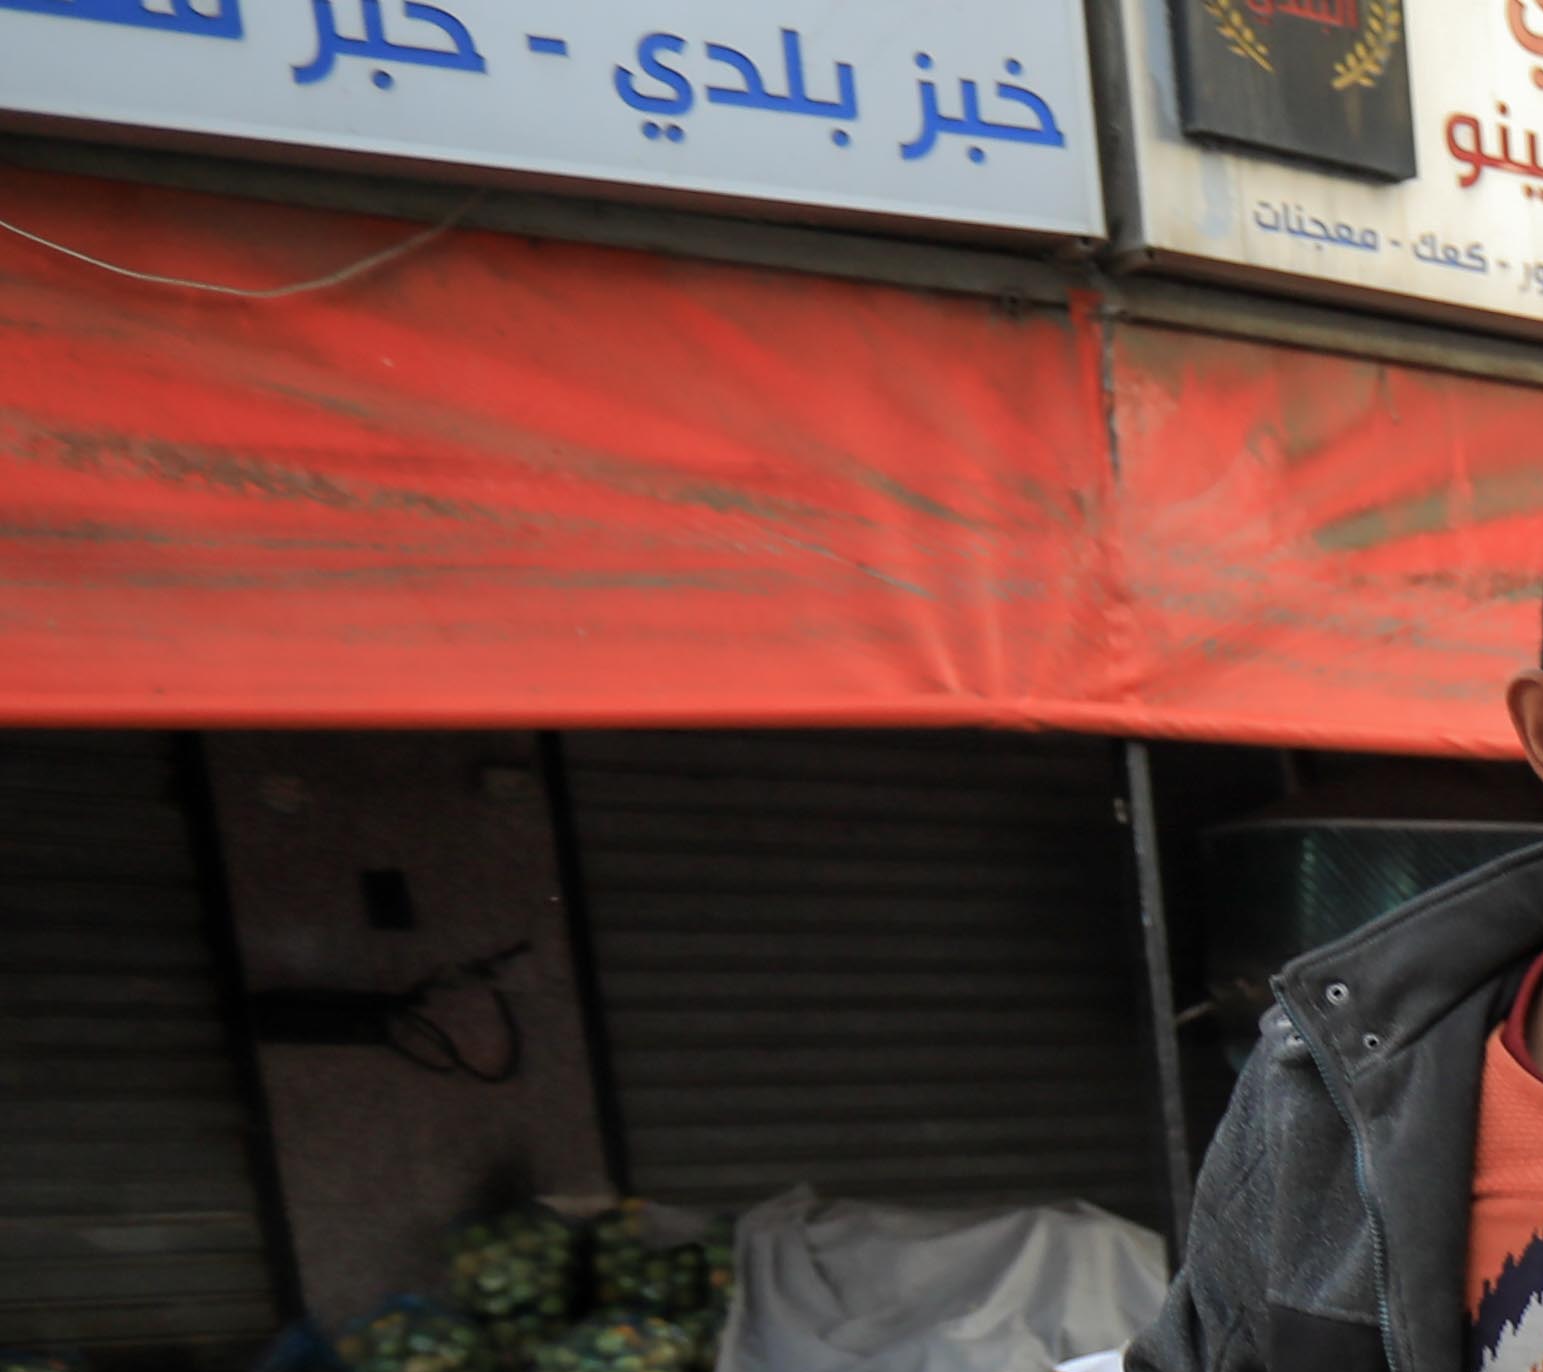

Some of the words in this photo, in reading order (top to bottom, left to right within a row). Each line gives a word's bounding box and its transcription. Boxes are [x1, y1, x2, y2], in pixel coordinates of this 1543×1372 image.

[609, 26, 861, 146] بلدي
[898, 52, 1069, 165] خبز
[1252, 201, 1380, 252] معجنات
[1411, 232, 1490, 275] كعك
